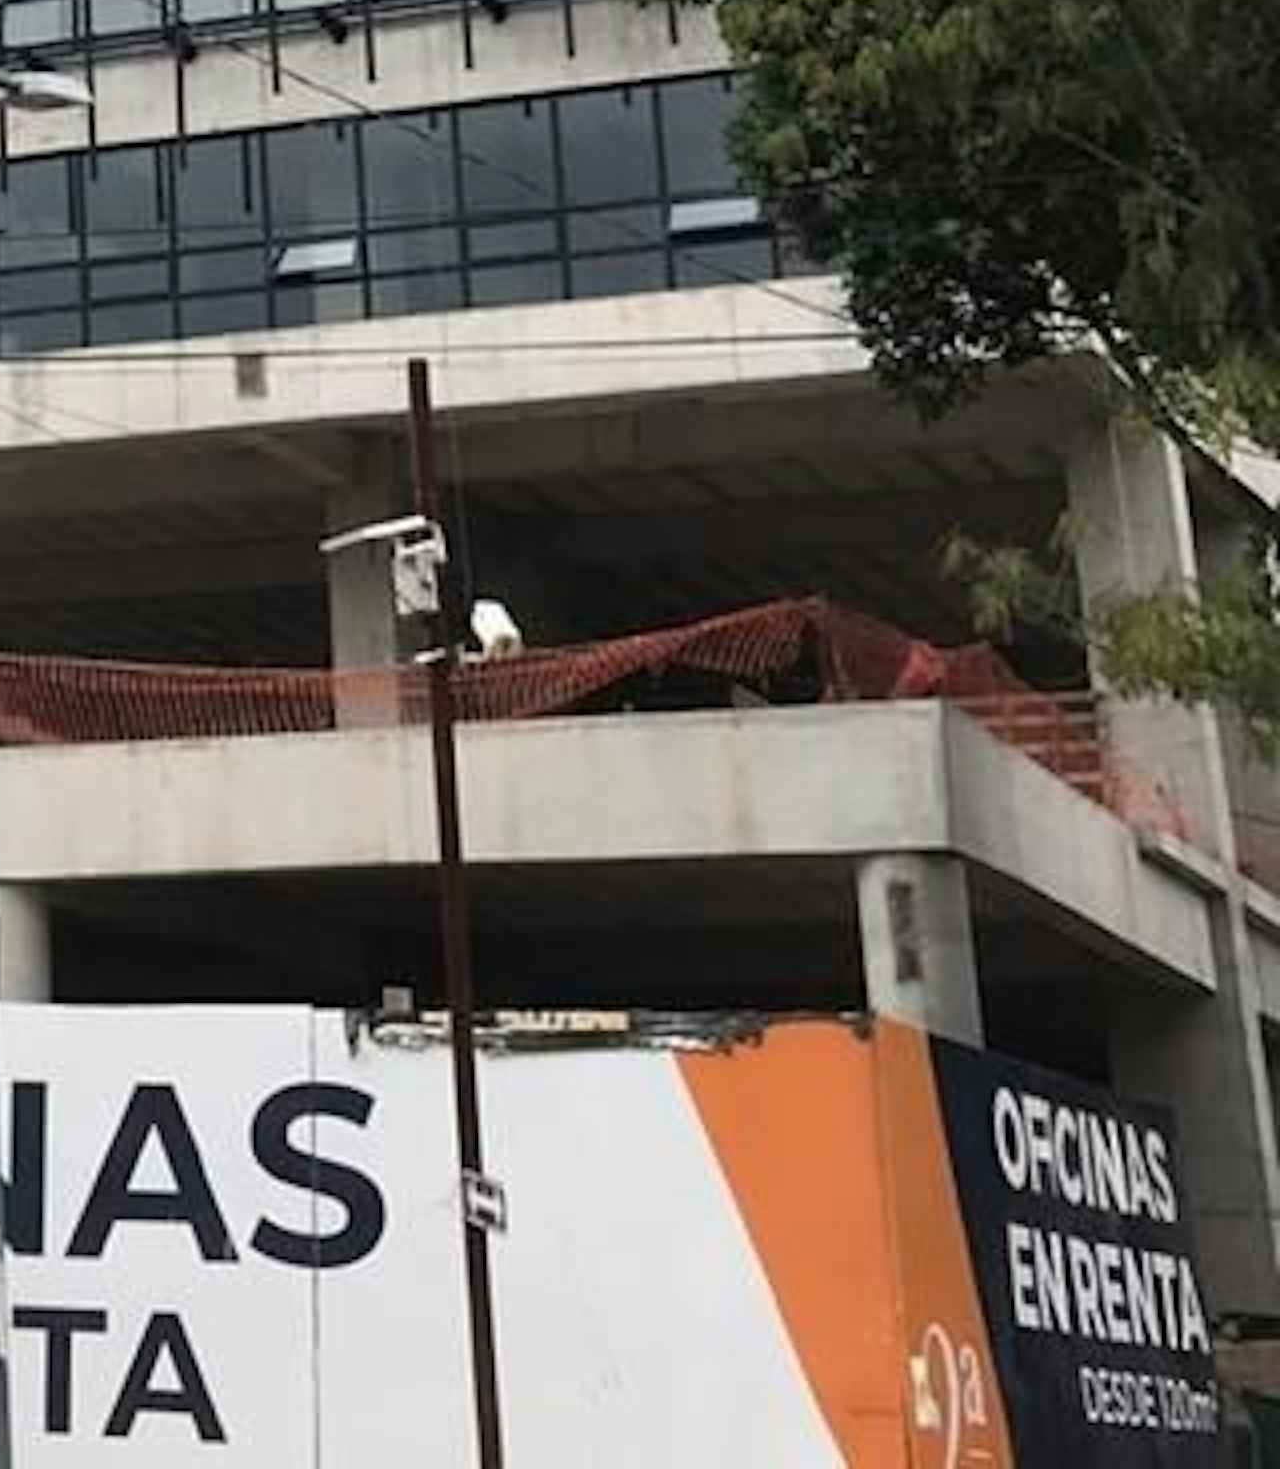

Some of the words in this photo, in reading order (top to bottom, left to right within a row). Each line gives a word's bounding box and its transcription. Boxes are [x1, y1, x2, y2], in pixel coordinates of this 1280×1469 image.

[993, 1087, 1180, 1223] OFICINAS
[1006, 1222, 1070, 1335] EN
[1067, 1234, 1211, 1355] RENTA
[1080, 1365, 1159, 1428] DESDE
